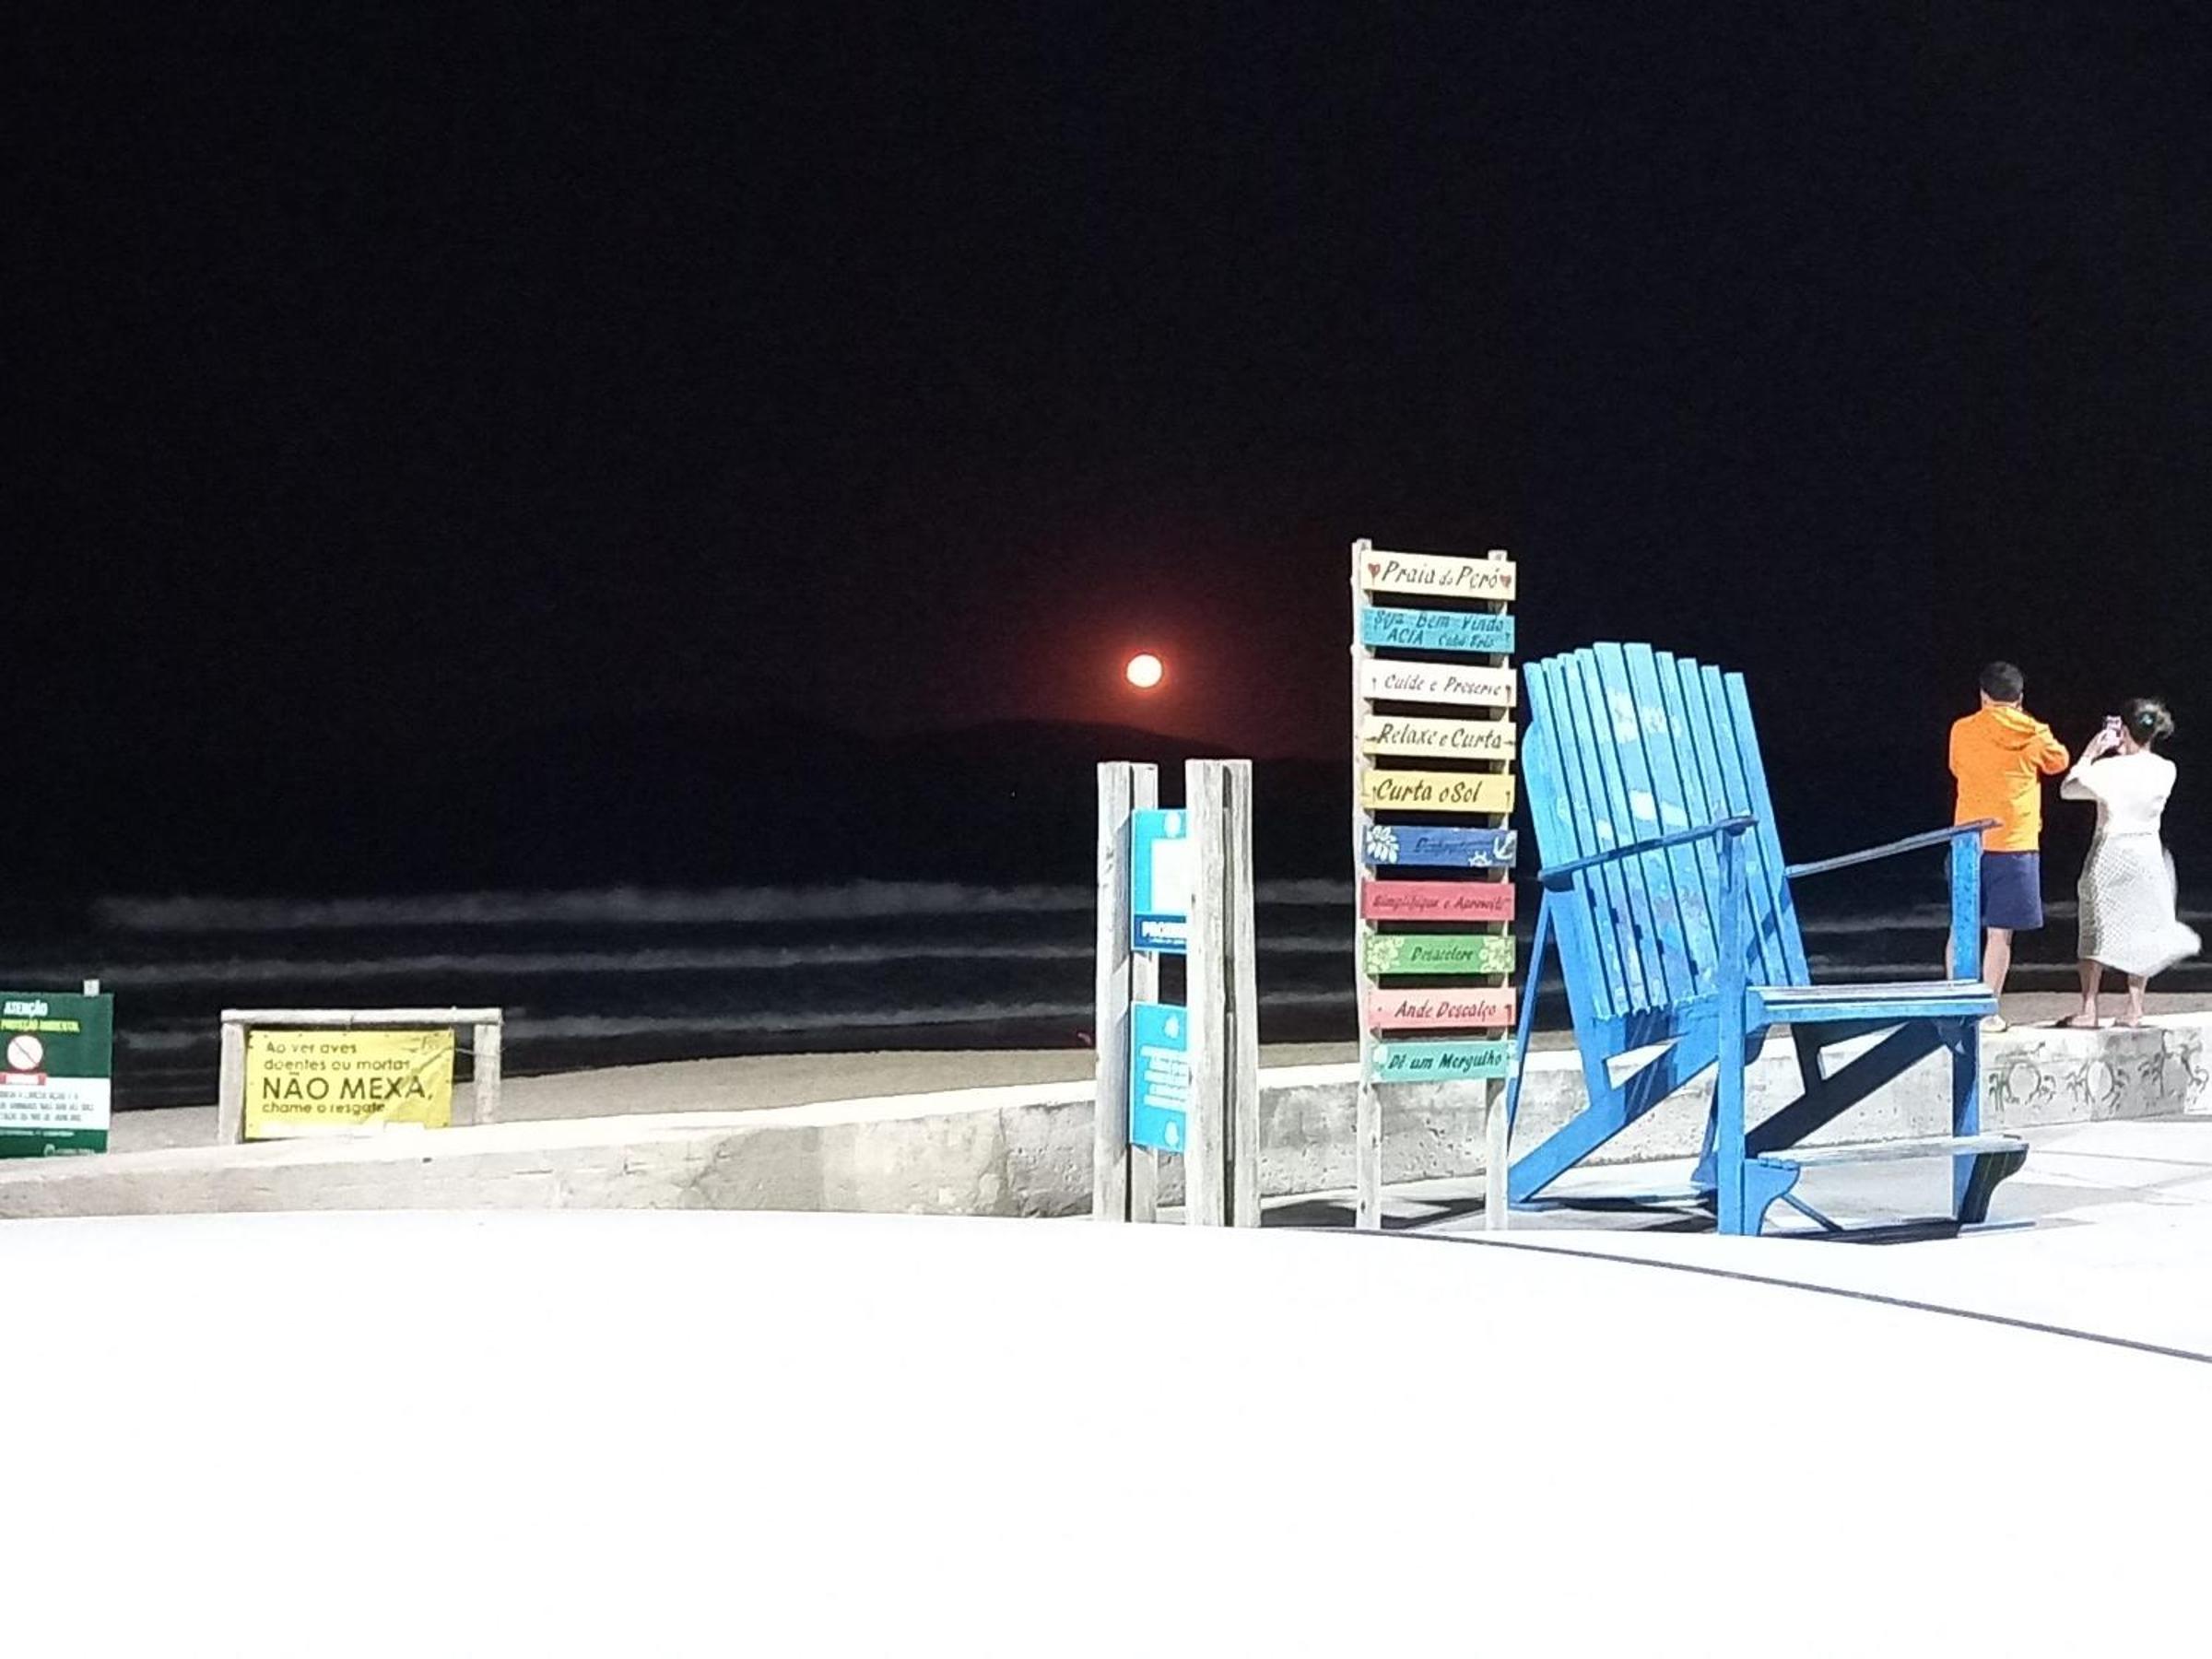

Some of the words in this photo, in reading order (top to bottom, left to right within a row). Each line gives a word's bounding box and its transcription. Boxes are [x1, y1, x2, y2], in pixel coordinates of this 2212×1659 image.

[1382, 560, 1436, 584] Praia
[1439, 570, 1453, 586] do
[1455, 565, 1500, 589] Peró
[1416, 611, 1450, 629] Bem
[1386, 628, 1424, 645] ACIA
[1384, 674, 1425, 690] Cuide
[1430, 680, 1438, 691] e
[1377, 723, 1438, 745] Relaxe
[1439, 734, 1449, 747] e
[1451, 727, 1502, 749] Curta
[1377, 778, 1432, 802] Curta
[1439, 787, 1450, 803] o
[1451, 781, 1482, 803] Sol
[1394, 998, 1433, 1018] Ande
[1436, 999, 1496, 1022] Descalço
[265, 1041, 286, 1053] Ao
[291, 1042, 314, 1053] ver
[320, 1042, 357, 1053] aves
[264, 1059, 325, 1071] doentes
[332, 1061, 351, 1071] ou
[1409, 1058, 1434, 1069] um
[1439, 1050, 1502, 1073] Mergulho
[263, 1072, 329, 1100] NÃO
[262, 1101, 312, 1113] chame
[316, 1104, 326, 1113] o
[330, 1101, 385, 1115] resgate
